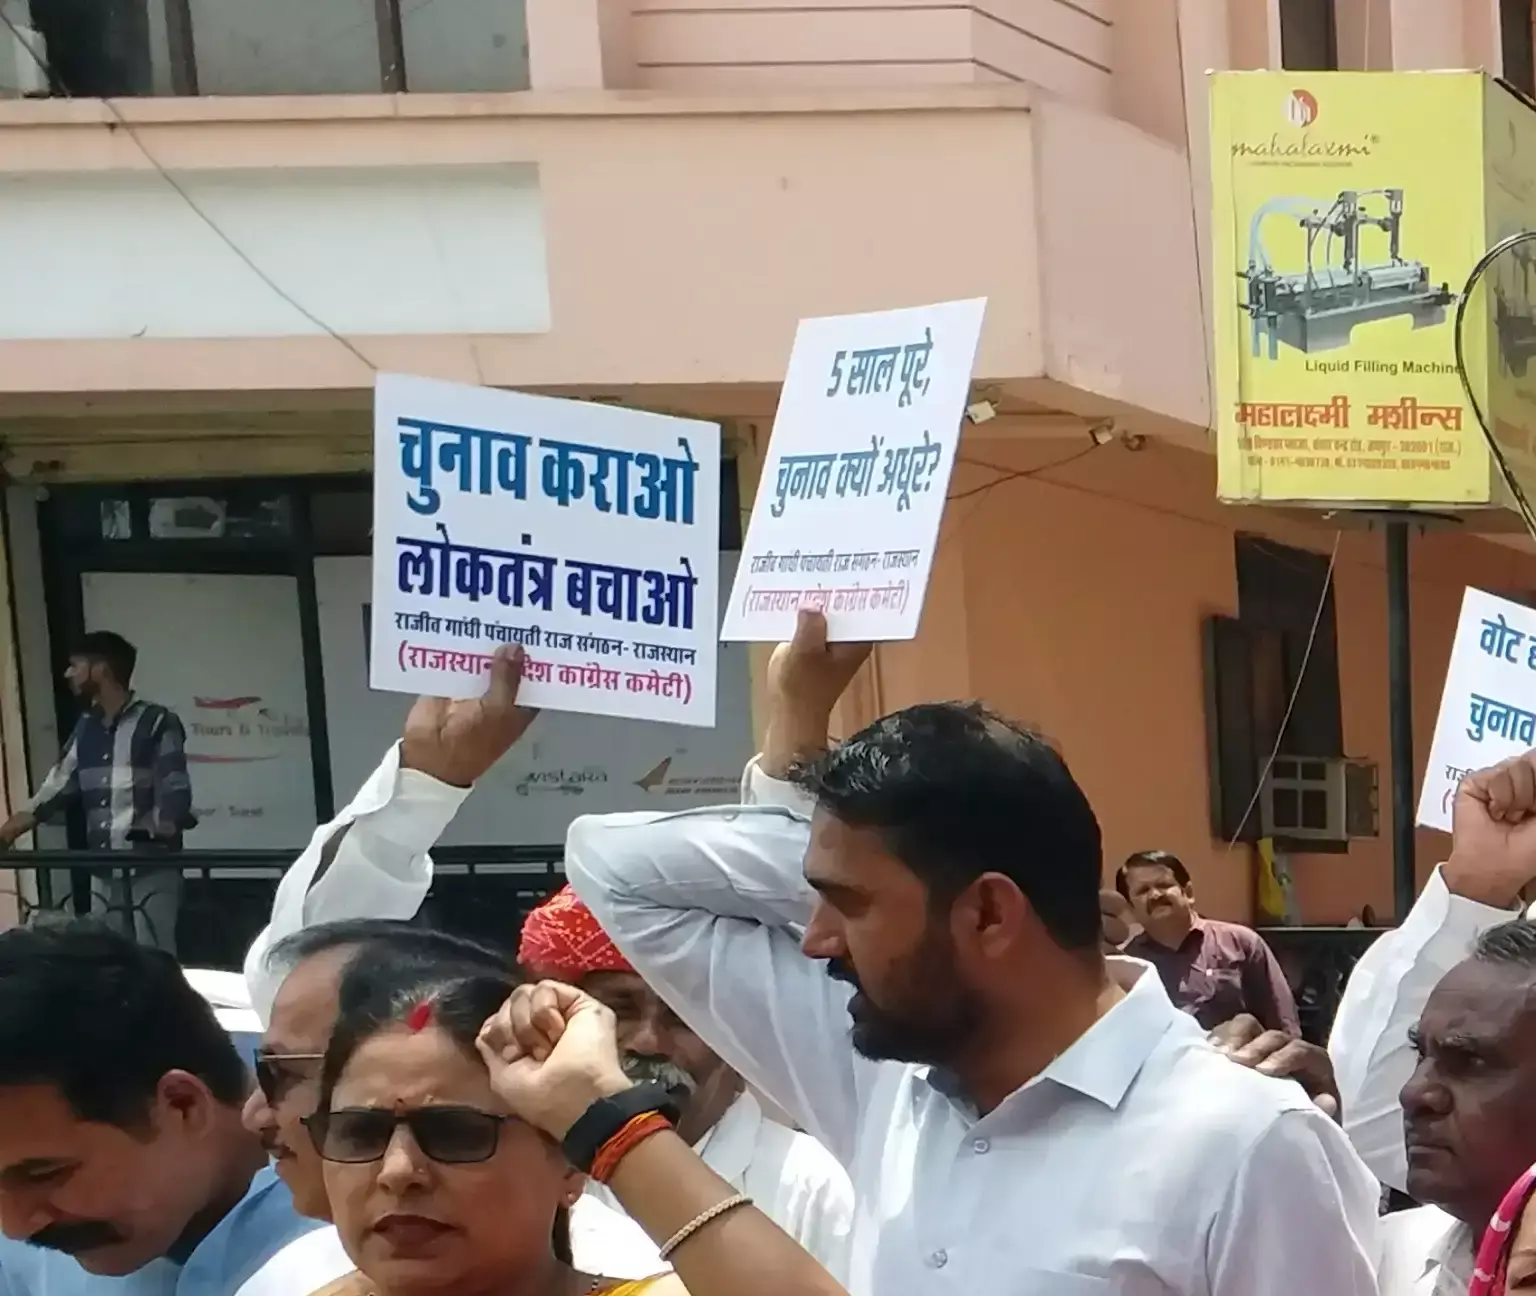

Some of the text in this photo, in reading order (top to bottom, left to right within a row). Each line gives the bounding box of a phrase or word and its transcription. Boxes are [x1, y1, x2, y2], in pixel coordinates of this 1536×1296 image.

[1231, 133, 1371, 157] mahalaxmi
[827, 327, 933, 407] 5 साल पूरे,
[1305, 360, 1349, 375] Liquid
[1354, 360, 1397, 375] Filling
[1235, 395, 1463, 431] महालक्ष्मी मशीन्स
[397, 416, 699, 525] चुनाव कराओ
[770, 430, 942, 518] चुनाव क्यों अधूरे?
[396, 523, 698, 630] लोकतंत्र बचाओ
[394, 611, 441, 633] राजीव
[444, 616, 481, 639] गांधी
[485, 622, 541, 647] पंचायती
[544, 630, 573, 650] राज
[632, 642, 696, 665] राजस्थान
[1479, 614, 1525, 664] वोट
[558, 660, 621, 691] कांग्रेस
[626, 667, 692, 704] कमेटी)
